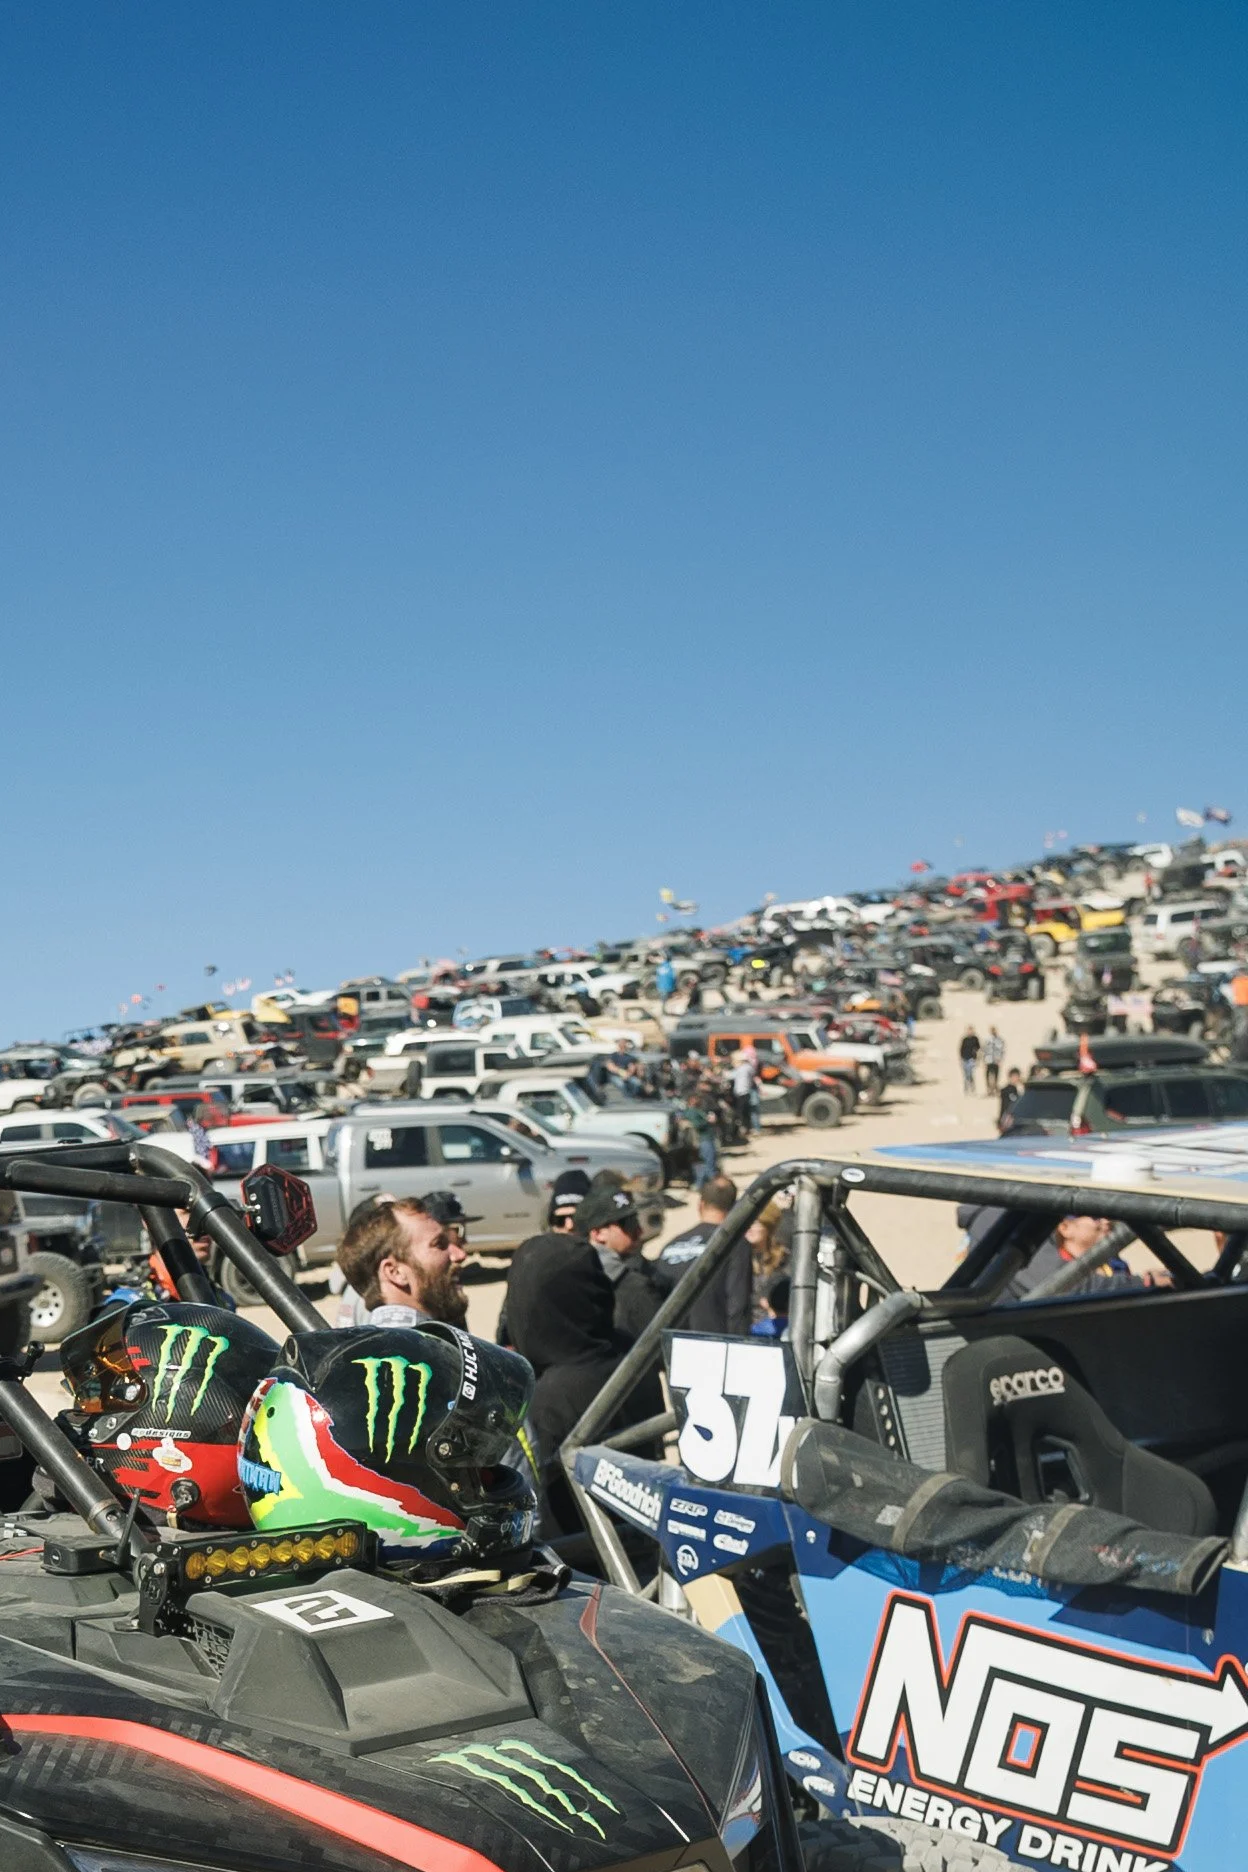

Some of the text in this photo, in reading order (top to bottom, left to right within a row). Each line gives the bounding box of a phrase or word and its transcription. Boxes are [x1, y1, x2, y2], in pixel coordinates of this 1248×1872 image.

[463, 1348, 479, 1382] HJC
[990, 1366, 1065, 1406] sparco
[593, 1458, 662, 1522] BFGoodrich
[284, 1595, 358, 1626] 2
[854, 1601, 1207, 1850] NOS
[847, 1768, 1014, 1847] ENERGY
